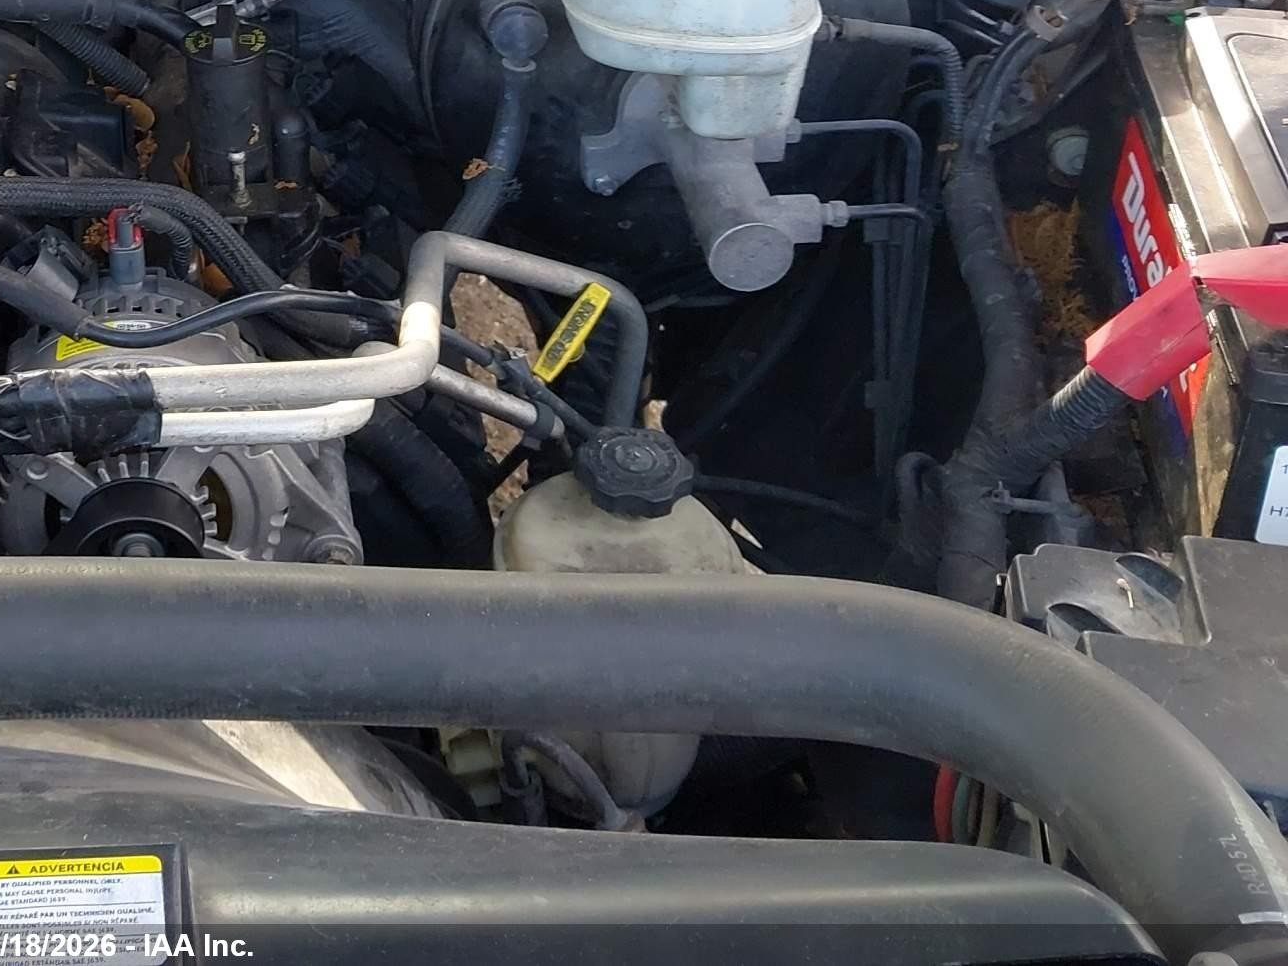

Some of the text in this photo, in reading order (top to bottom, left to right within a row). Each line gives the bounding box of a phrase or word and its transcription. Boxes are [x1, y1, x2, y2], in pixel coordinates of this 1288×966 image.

[1122, 151, 1172, 289] Dura
[30, 862, 125, 873] ADVERTENCIA
[11, 897, 47, 905] STANDARD
